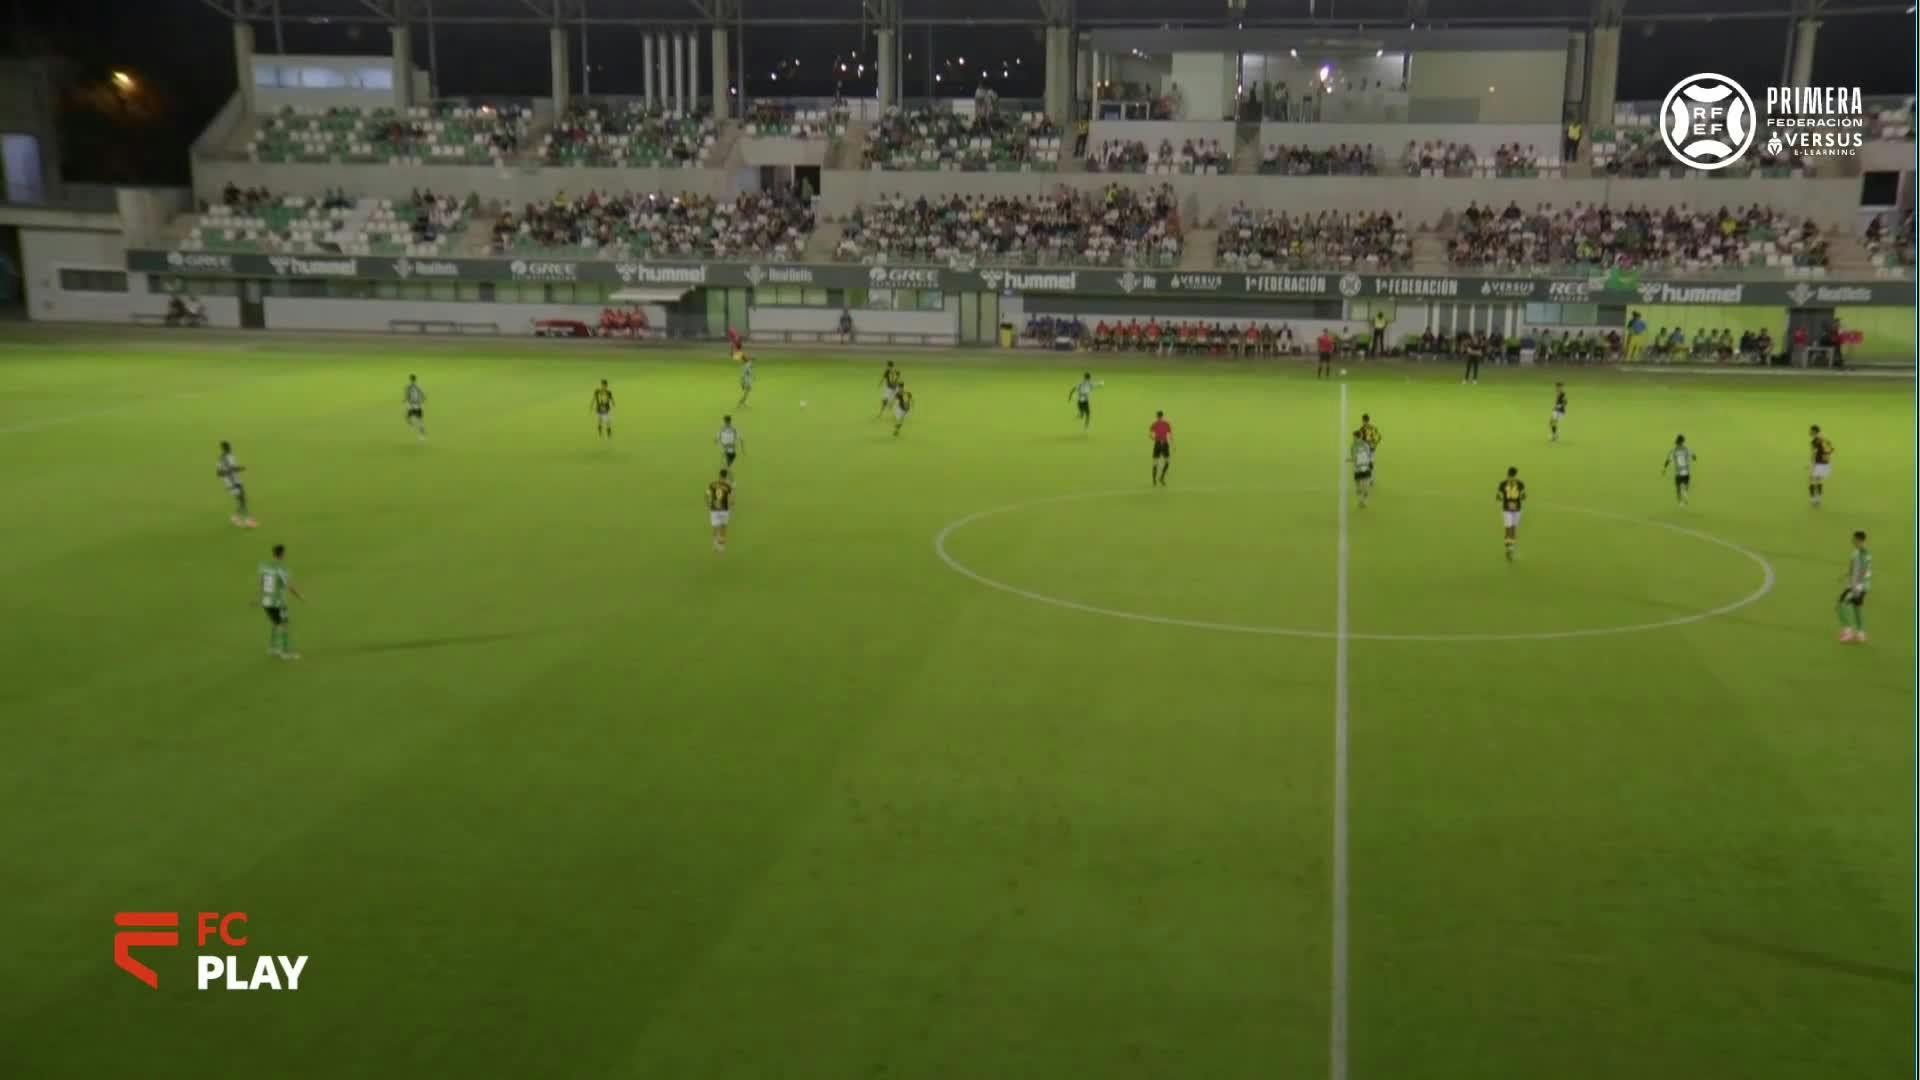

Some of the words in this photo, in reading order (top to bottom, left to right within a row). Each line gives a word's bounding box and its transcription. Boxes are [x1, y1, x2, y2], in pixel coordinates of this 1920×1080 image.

[291, 257, 357, 275] hummel
[638, 265, 706, 283] hummel
[1005, 271, 1076, 290] hummel
[1180, 275, 1222, 286] VERSUS
[1258, 274, 1326, 293] FEDERACIÓN
[1389, 278, 1458, 296] FEDERACIÓN
[1491, 281, 1534, 292] VERSUS
[1661, 284, 1744, 303] hummel
